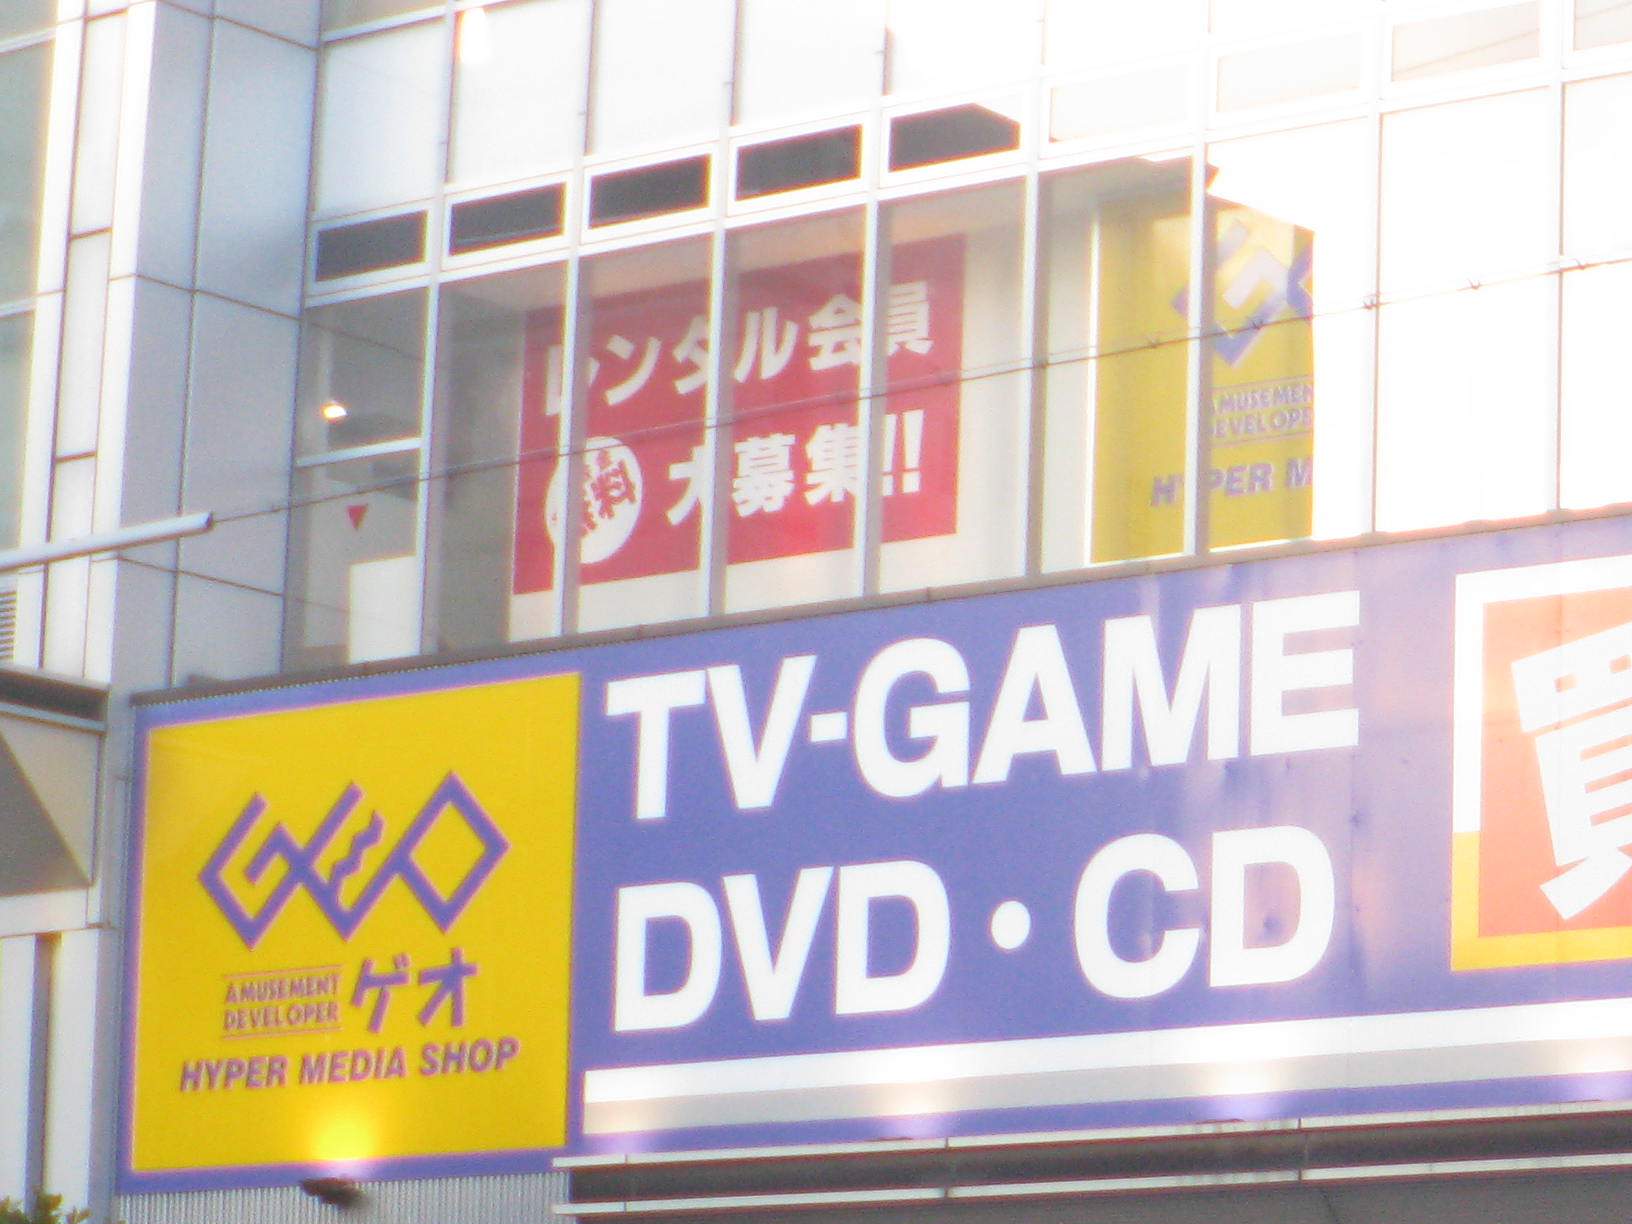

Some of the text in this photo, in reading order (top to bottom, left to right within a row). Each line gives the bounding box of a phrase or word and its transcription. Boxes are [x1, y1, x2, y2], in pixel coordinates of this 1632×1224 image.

[606, 591, 1360, 819] TV-GAME
[200, 770, 510, 950] GEO
[224, 1001, 339, 1030] DEVELOPER
[225, 975, 341, 1004] AMUSEMENT
[352, 946, 481, 1034] ゲオ
[180, 1037, 520, 1091] HYPER MEDIA SHOP
